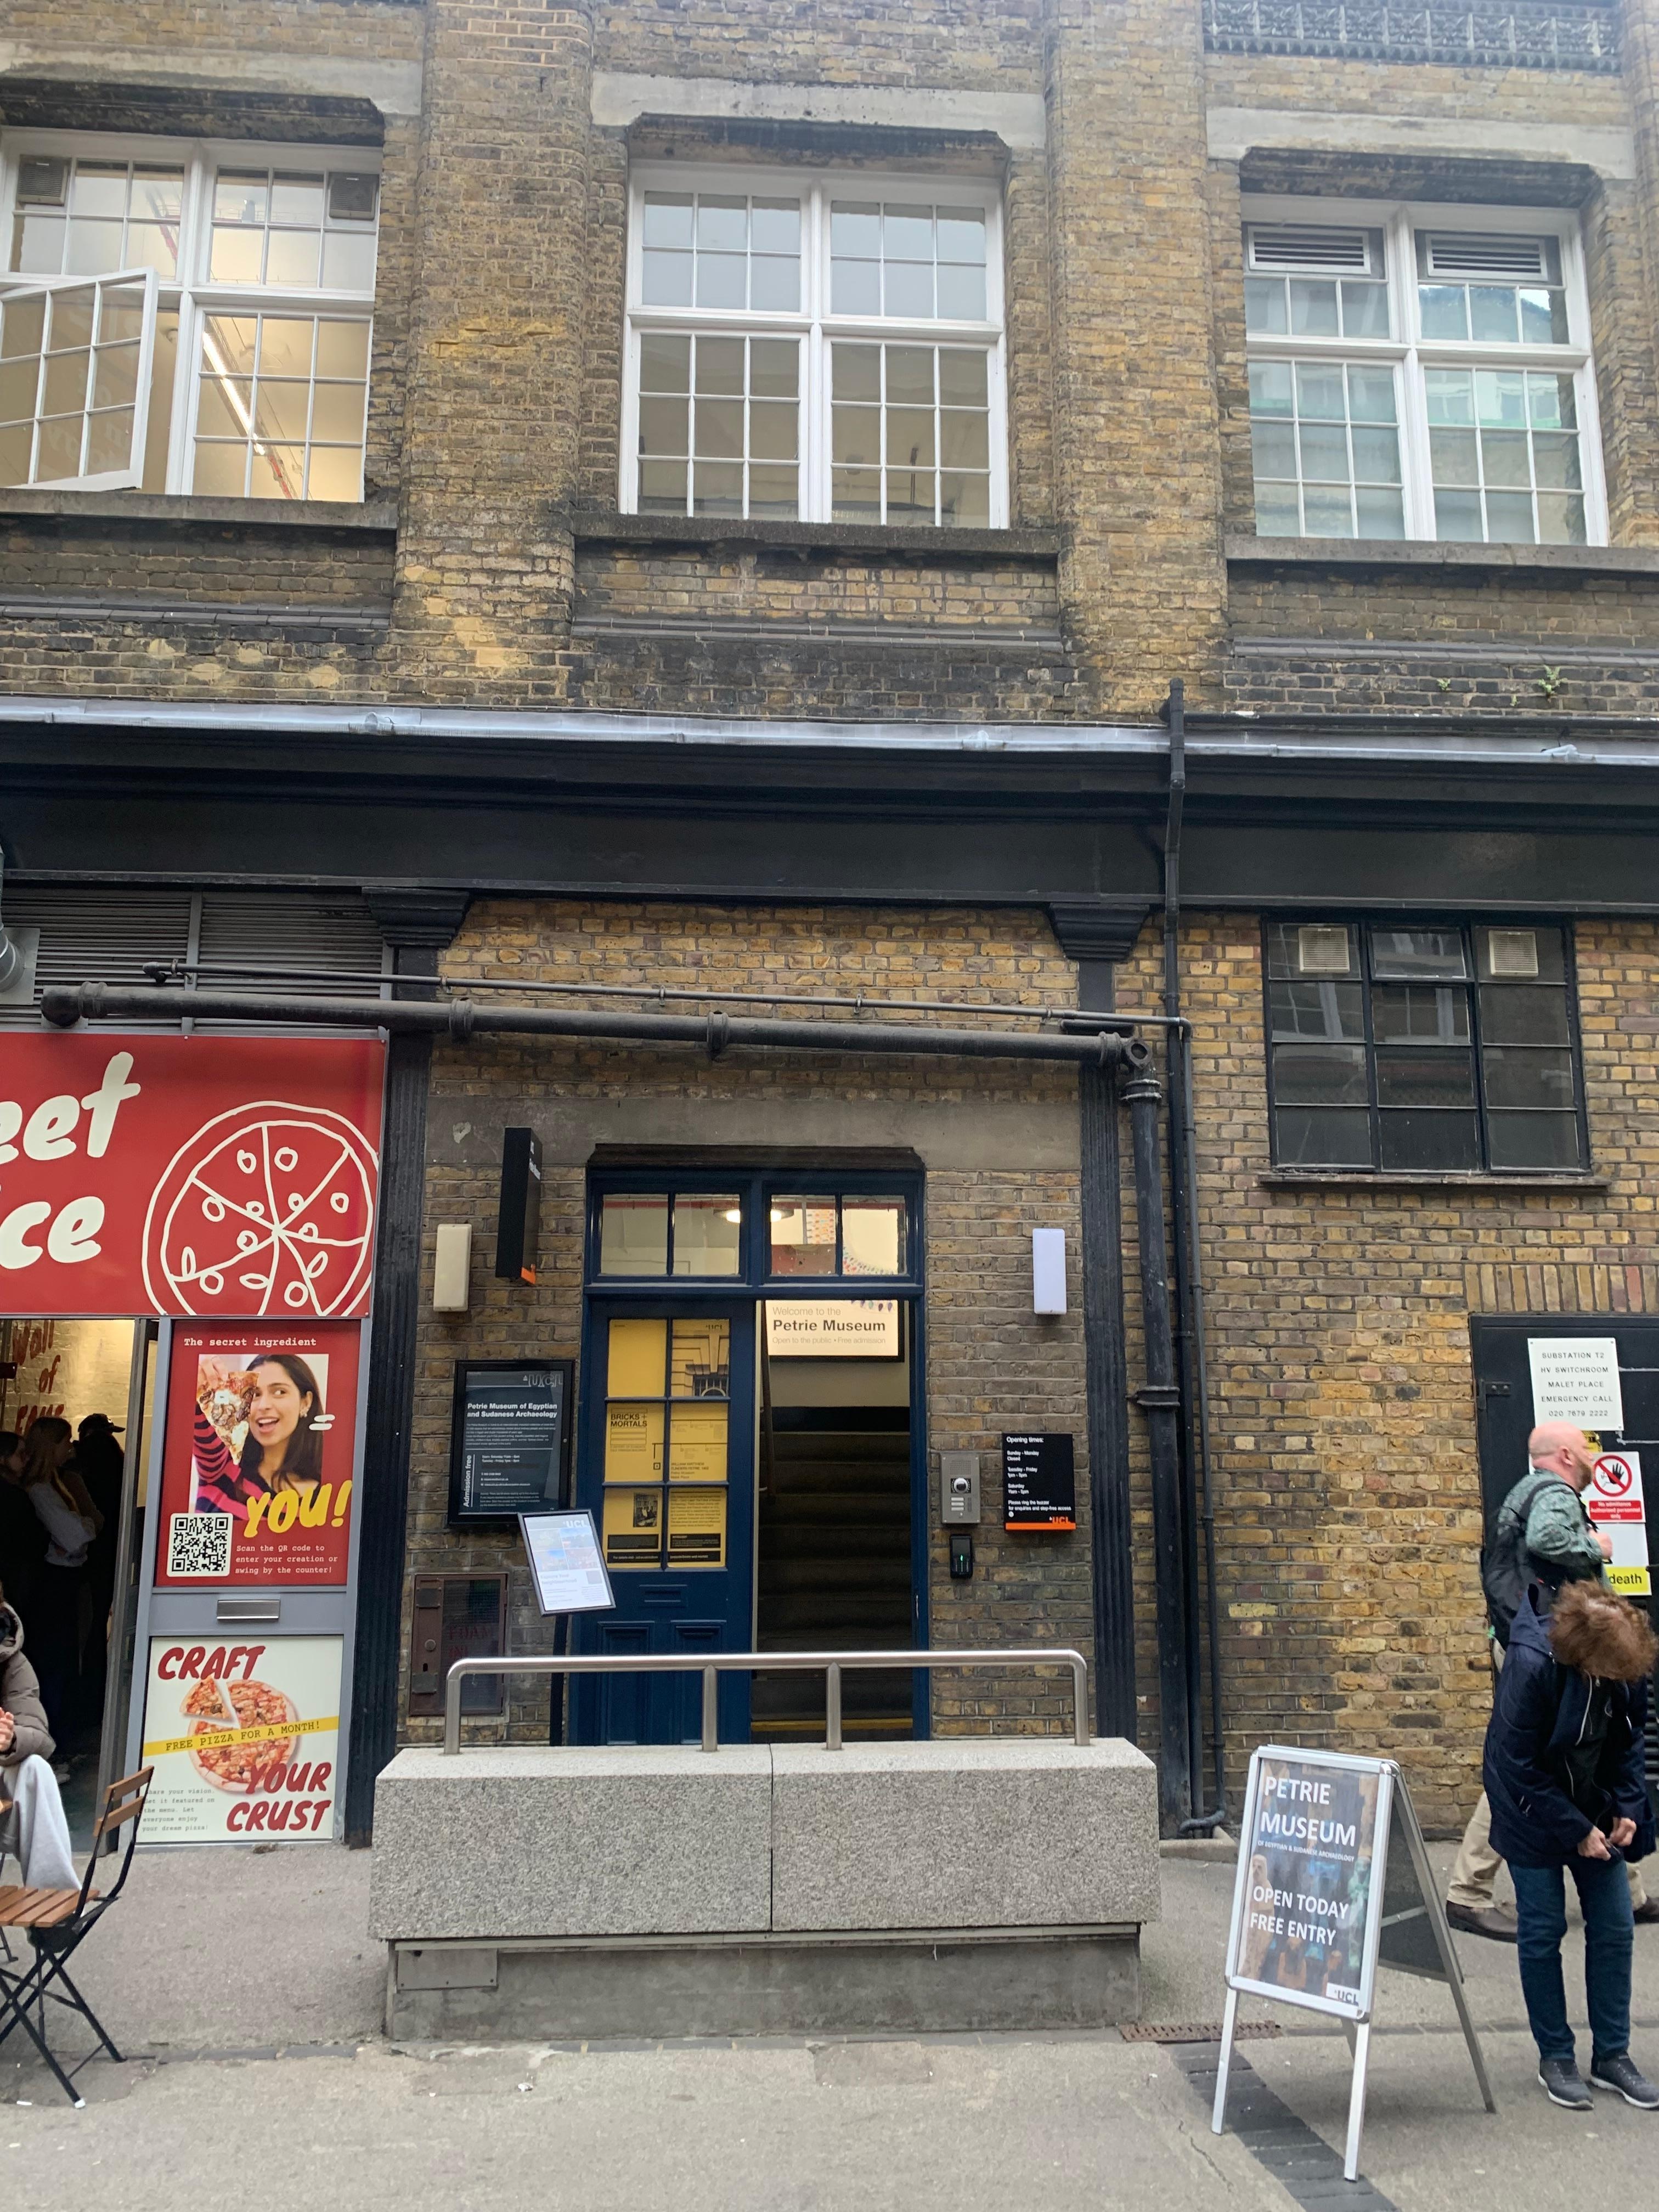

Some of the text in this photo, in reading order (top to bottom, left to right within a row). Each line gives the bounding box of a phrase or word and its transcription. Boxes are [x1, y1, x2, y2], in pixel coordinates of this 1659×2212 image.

[772, 1307, 814, 1316] Welcome
[827, 1307, 841, 1316] the
[773, 1319, 885, 1331] Petrie Museum
[184, 1337, 317, 1347] The secret ingredient
[528, 1374, 563, 1387] UCL
[528, 1402, 557, 1410] Egyptian
[244, 1480, 353, 1538] YOU!
[566, 1520, 589, 1528] UCL
[235, 1566, 259, 1575] swing
[1609, 1573, 1642, 1584] death
[157, 1645, 266, 1680] CRAFT
[166, 1720, 320, 1751] FREE PIZZA FOR A MONTH!
[245, 1762, 332, 1794] YOUR
[1264, 1776, 1331, 1805] PETRIE
[226, 1800, 332, 1832] CRUST
[1261, 1812, 1356, 1847] MUSEUM
[1265, 1841, 1288, 1850] EGYPTIAN
[1293, 1846, 1318, 1856] SUDANESE
[1318, 1850, 1355, 1863] ARCHAEOLOGY
[1253, 1885, 1349, 1920] OPEN TODAY
[1250, 1912, 1337, 1946] FREE ENTRY
[1338, 1989, 1359, 2006] UCL
